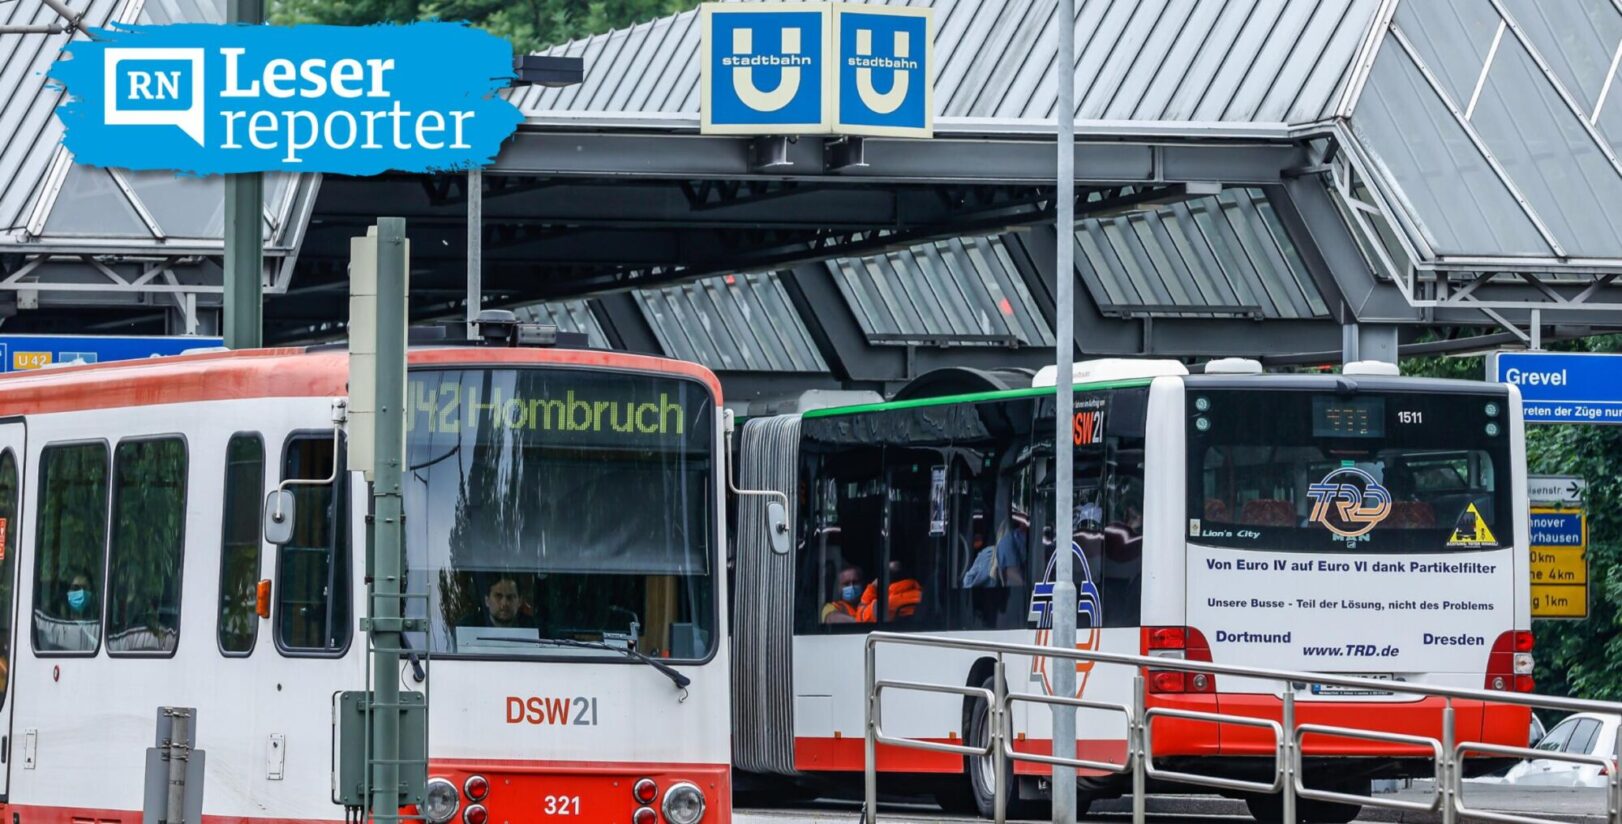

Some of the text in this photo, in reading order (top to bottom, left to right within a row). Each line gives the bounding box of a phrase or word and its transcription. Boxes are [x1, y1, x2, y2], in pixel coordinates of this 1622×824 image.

[722, 55, 812, 66] stadtbahn
[848, 57, 918, 69] stadtbahn
[1505, 367, 1567, 386] Grevel
[468, 387, 684, 434] Hombruch
[1523, 406, 1551, 416] reten
[1554, 406, 1573, 417] der
[1574, 406, 1603, 419] Züge
[1397, 411, 1423, 424] 1511
[1072, 411, 1104, 445] SW21
[1306, 483, 1392, 523] TRD
[1202, 529, 1261, 540] Lion's City
[1332, 533, 1371, 542] MAN
[1530, 550, 1556, 563] 0km
[1206, 558, 1497, 574] Von Euro IV auf Euro VI dank Partikelfilter
[1207, 598, 1248, 608] Unsere
[1250, 598, 1285, 608] Busse
[1296, 599, 1316, 609] Teil
[1319, 599, 1338, 609] der
[1341, 599, 1385, 611] Lösung,
[1388, 600, 1416, 610] nicht
[1419, 600, 1439, 610] des
[1442, 601, 1495, 611] Problems
[1215, 630, 1292, 643] Dortmund
[1423, 633, 1485, 646] Dresden
[1302, 645, 1400, 657] www.TRD.de
[506, 696, 598, 726] DSW21
[543, 795, 581, 816] 321
